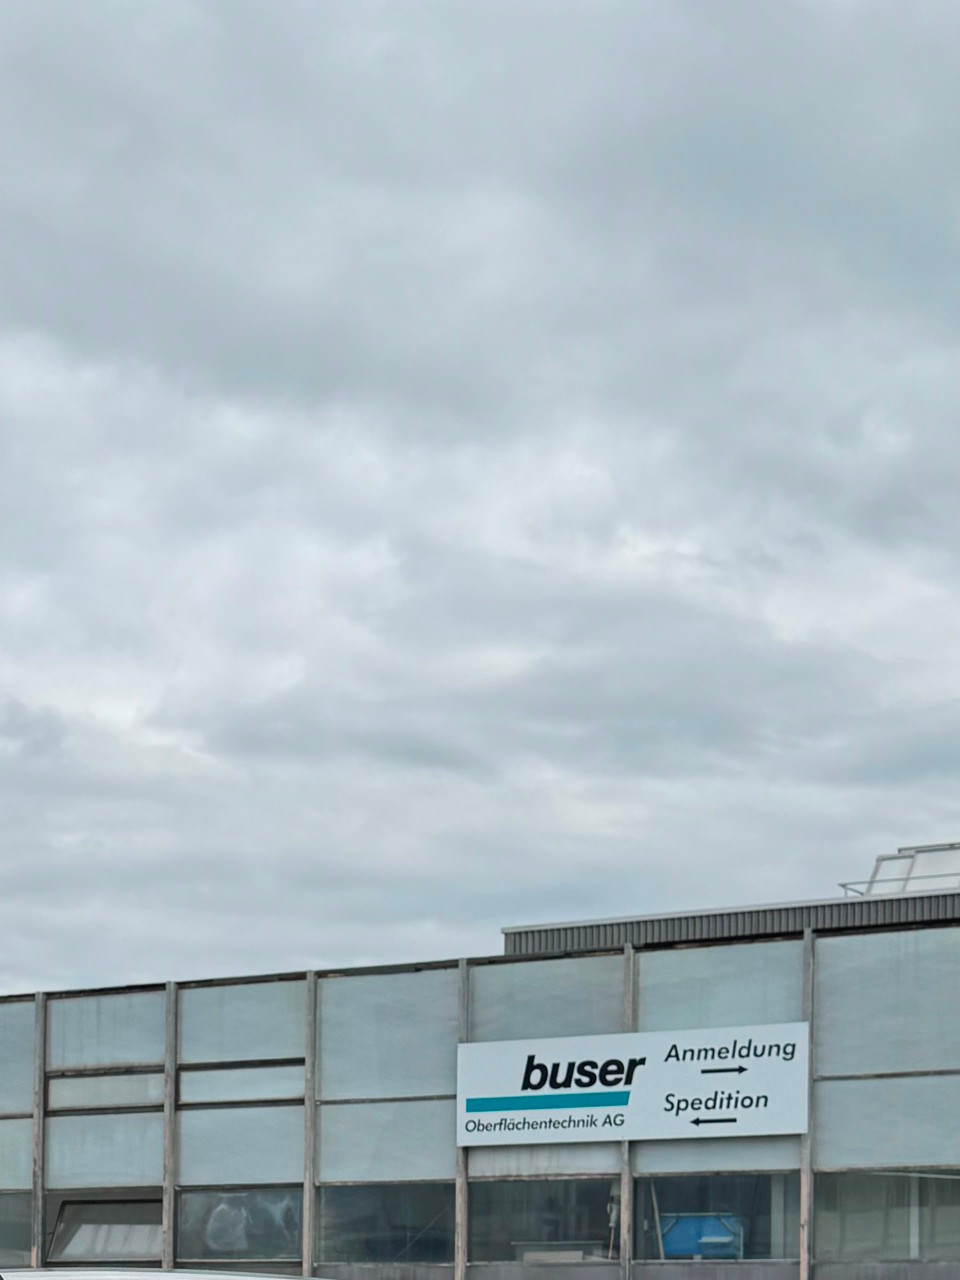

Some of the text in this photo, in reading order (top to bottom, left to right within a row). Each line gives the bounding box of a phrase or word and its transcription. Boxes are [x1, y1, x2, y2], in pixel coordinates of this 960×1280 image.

[664, 1039, 797, 1062] Anmeldung
[521, 1055, 646, 1090] buser
[663, 1090, 769, 1116] Spedition
[465, 1113, 625, 1133] Oberflächentechnik AG
